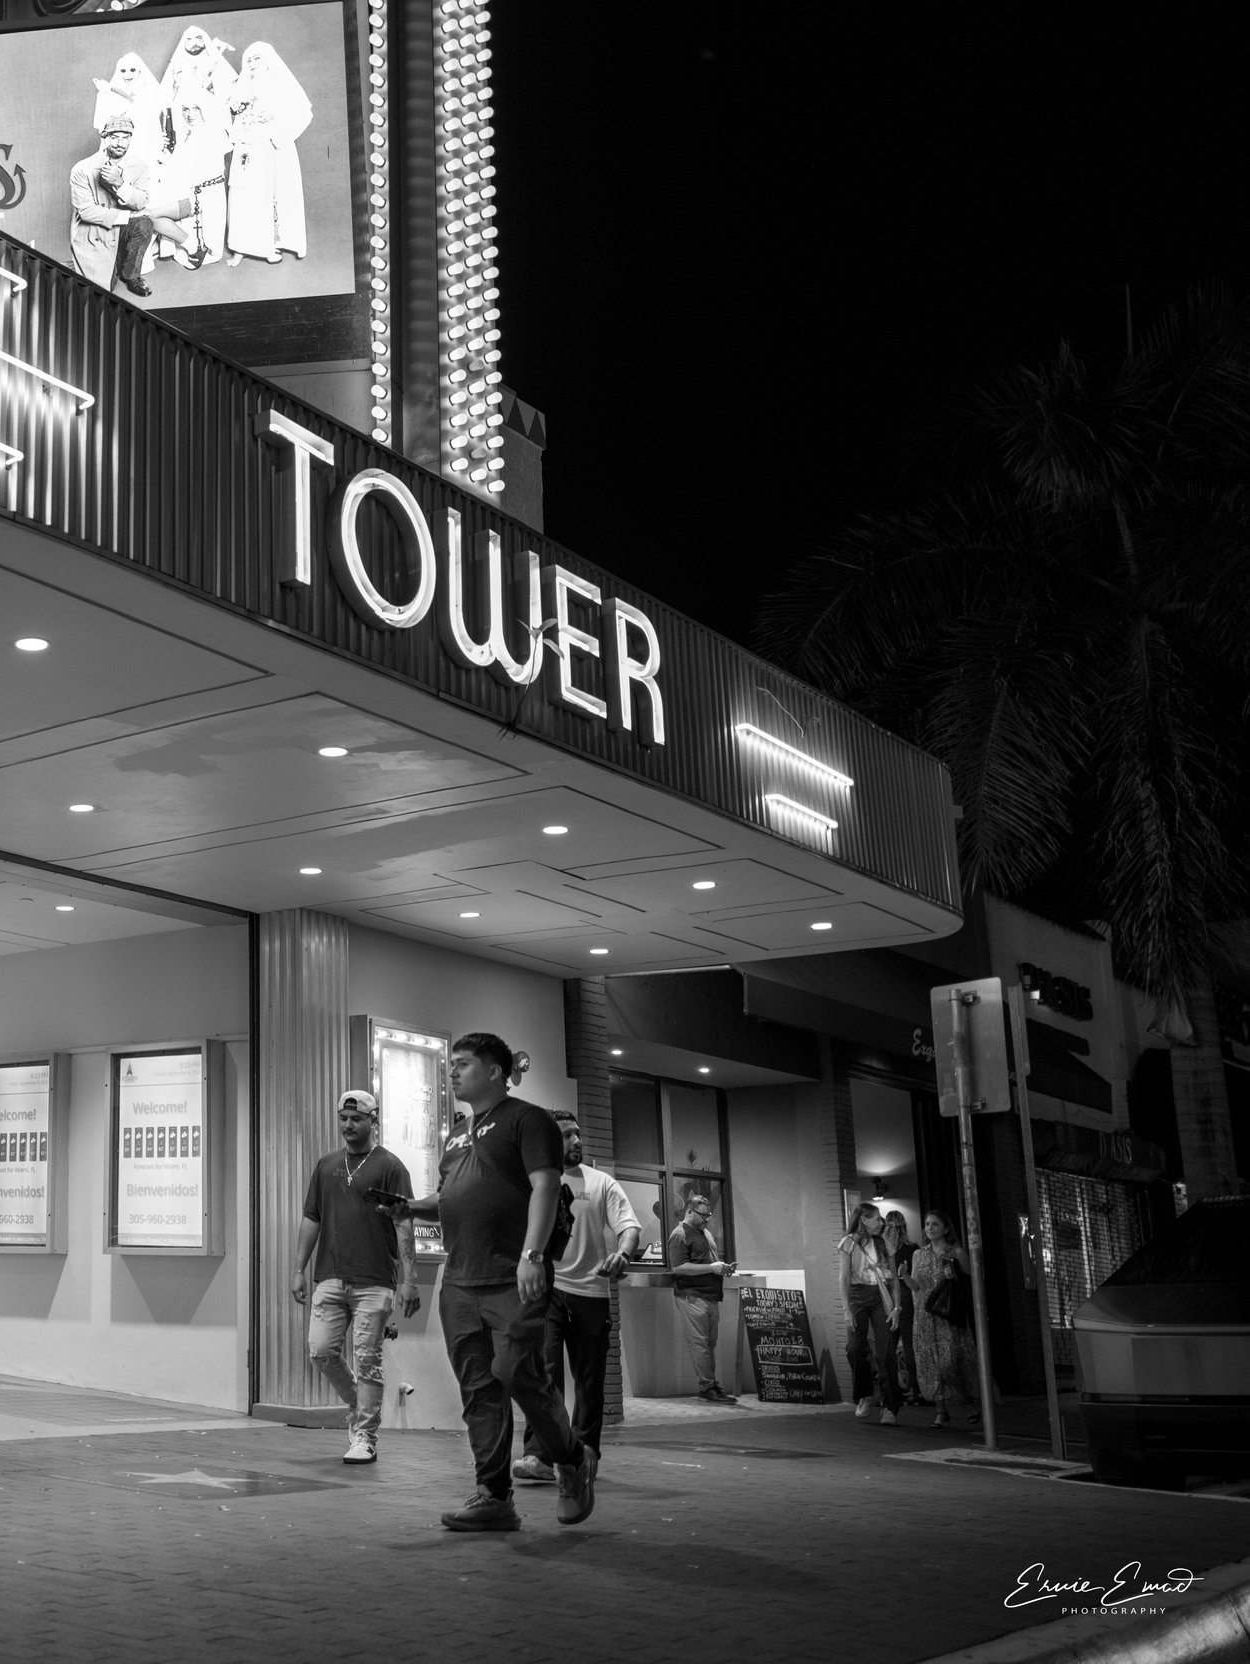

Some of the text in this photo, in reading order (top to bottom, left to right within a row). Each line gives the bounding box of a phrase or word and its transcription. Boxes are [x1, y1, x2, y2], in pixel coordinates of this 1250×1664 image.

[266, 408, 665, 746] TOWER
[132, 1100, 188, 1115] Welcome!
[126, 1183, 199, 1198] Bienvenidos!
[128, 1214, 188, 1225] 305-960-2938
[414, 1226, 435, 1238] AYING
[755, 1288, 797, 1301] EXQUISITO
